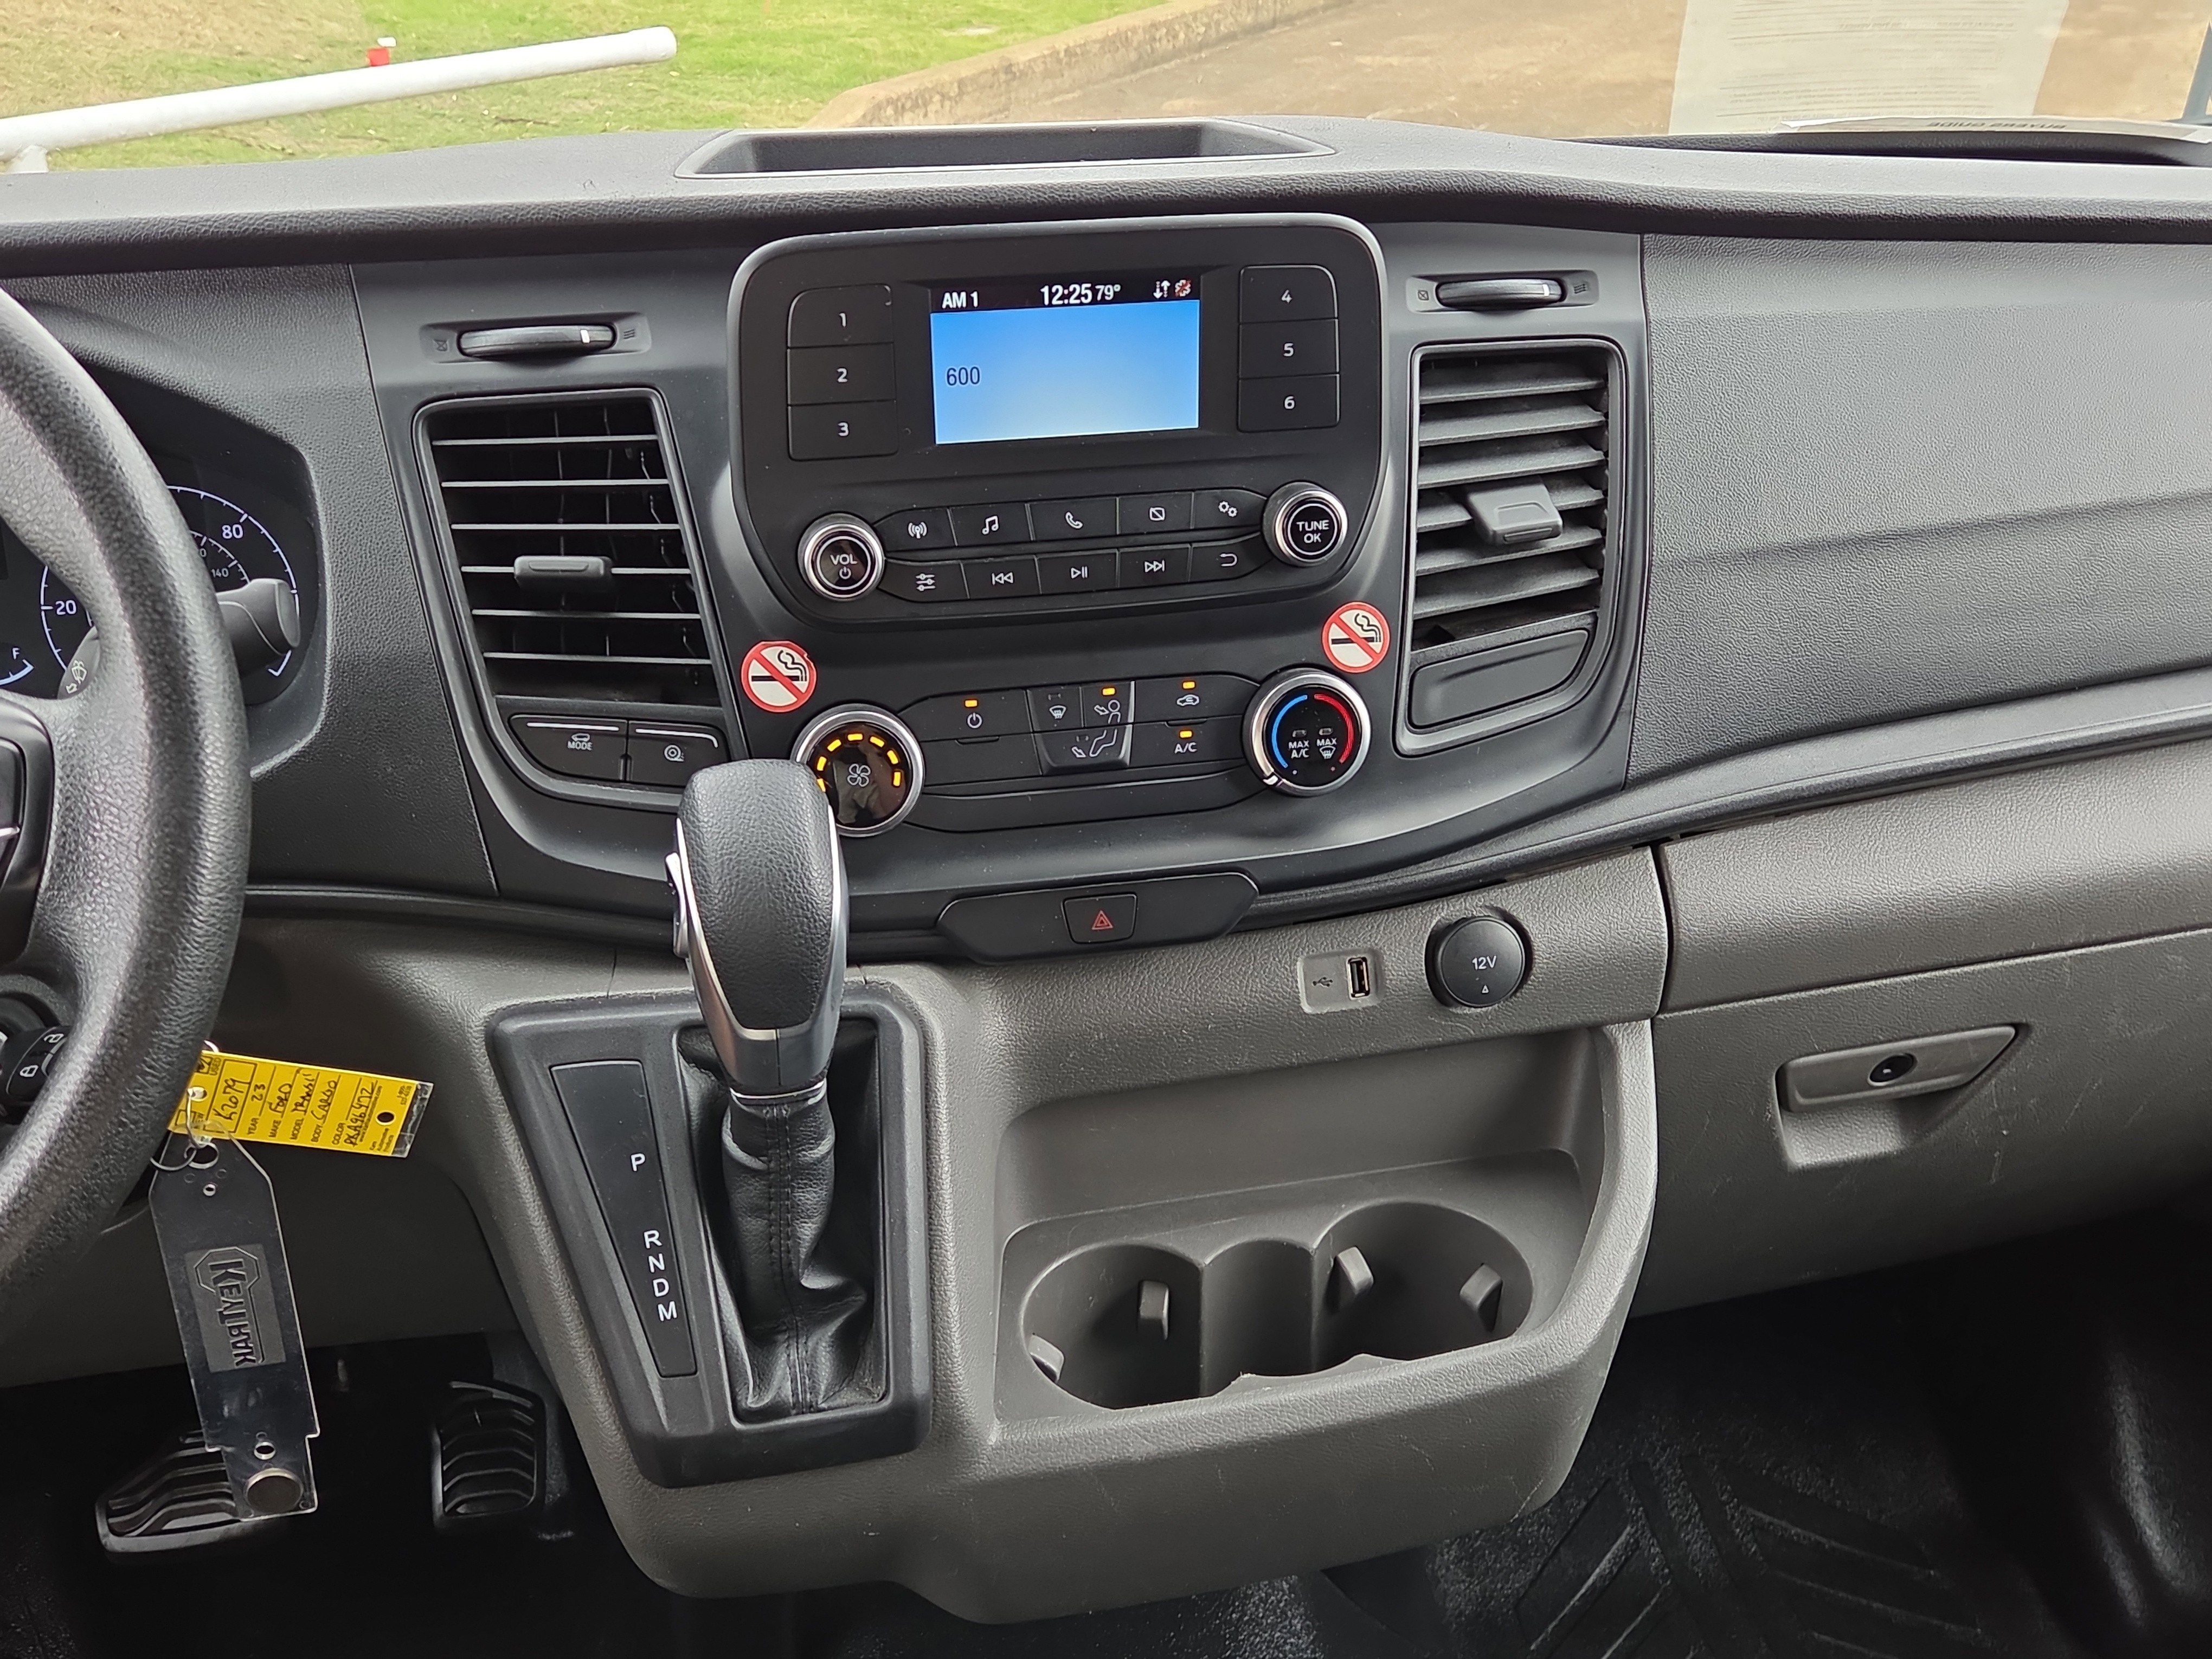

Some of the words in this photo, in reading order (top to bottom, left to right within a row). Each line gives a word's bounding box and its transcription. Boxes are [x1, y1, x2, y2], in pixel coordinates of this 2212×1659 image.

[942, 291, 967, 309] AM
[970, 291, 979, 307] 1
[1040, 283, 1092, 306] 12:25
[1281, 290, 1292, 303] 4
[839, 313, 846, 327] 1
[1284, 343, 1294, 357] 5
[837, 368, 847, 382] 2
[947, 366, 981, 386] 600
[1284, 396, 1295, 409] 6
[838, 422, 849, 436] 3
[222, 524, 243, 539] 80
[1296, 519, 1329, 532] TUNE
[1303, 532, 1322, 544] OK
[830, 553, 858, 565] VOL
[211, 568, 229, 578] 140
[55, 600, 76, 615] 20
[12, 647, 20, 660] F
[568, 741, 593, 751] MODE
[1174, 742, 1198, 754] A/C
[1288, 740, 1309, 749] MAX
[1316, 737, 1337, 747] MAX
[1291, 748, 1309, 759] A/C
[1472, 955, 1497, 970] 12V
[251, 1084, 265, 1102] 23
[247, 1117, 260, 1135] YEAR
[268, 1120, 281, 1137] MAKE
[289, 1117, 304, 1140] MODEL
[311, 1124, 323, 1142] BODY
[332, 1122, 345, 1145] COLOR
[631, 1153, 646, 1172] P
[644, 1230, 663, 1249] R
[648, 1253, 665, 1273] N
[653, 1278, 670, 1297] D
[658, 1301, 677, 1321] M
